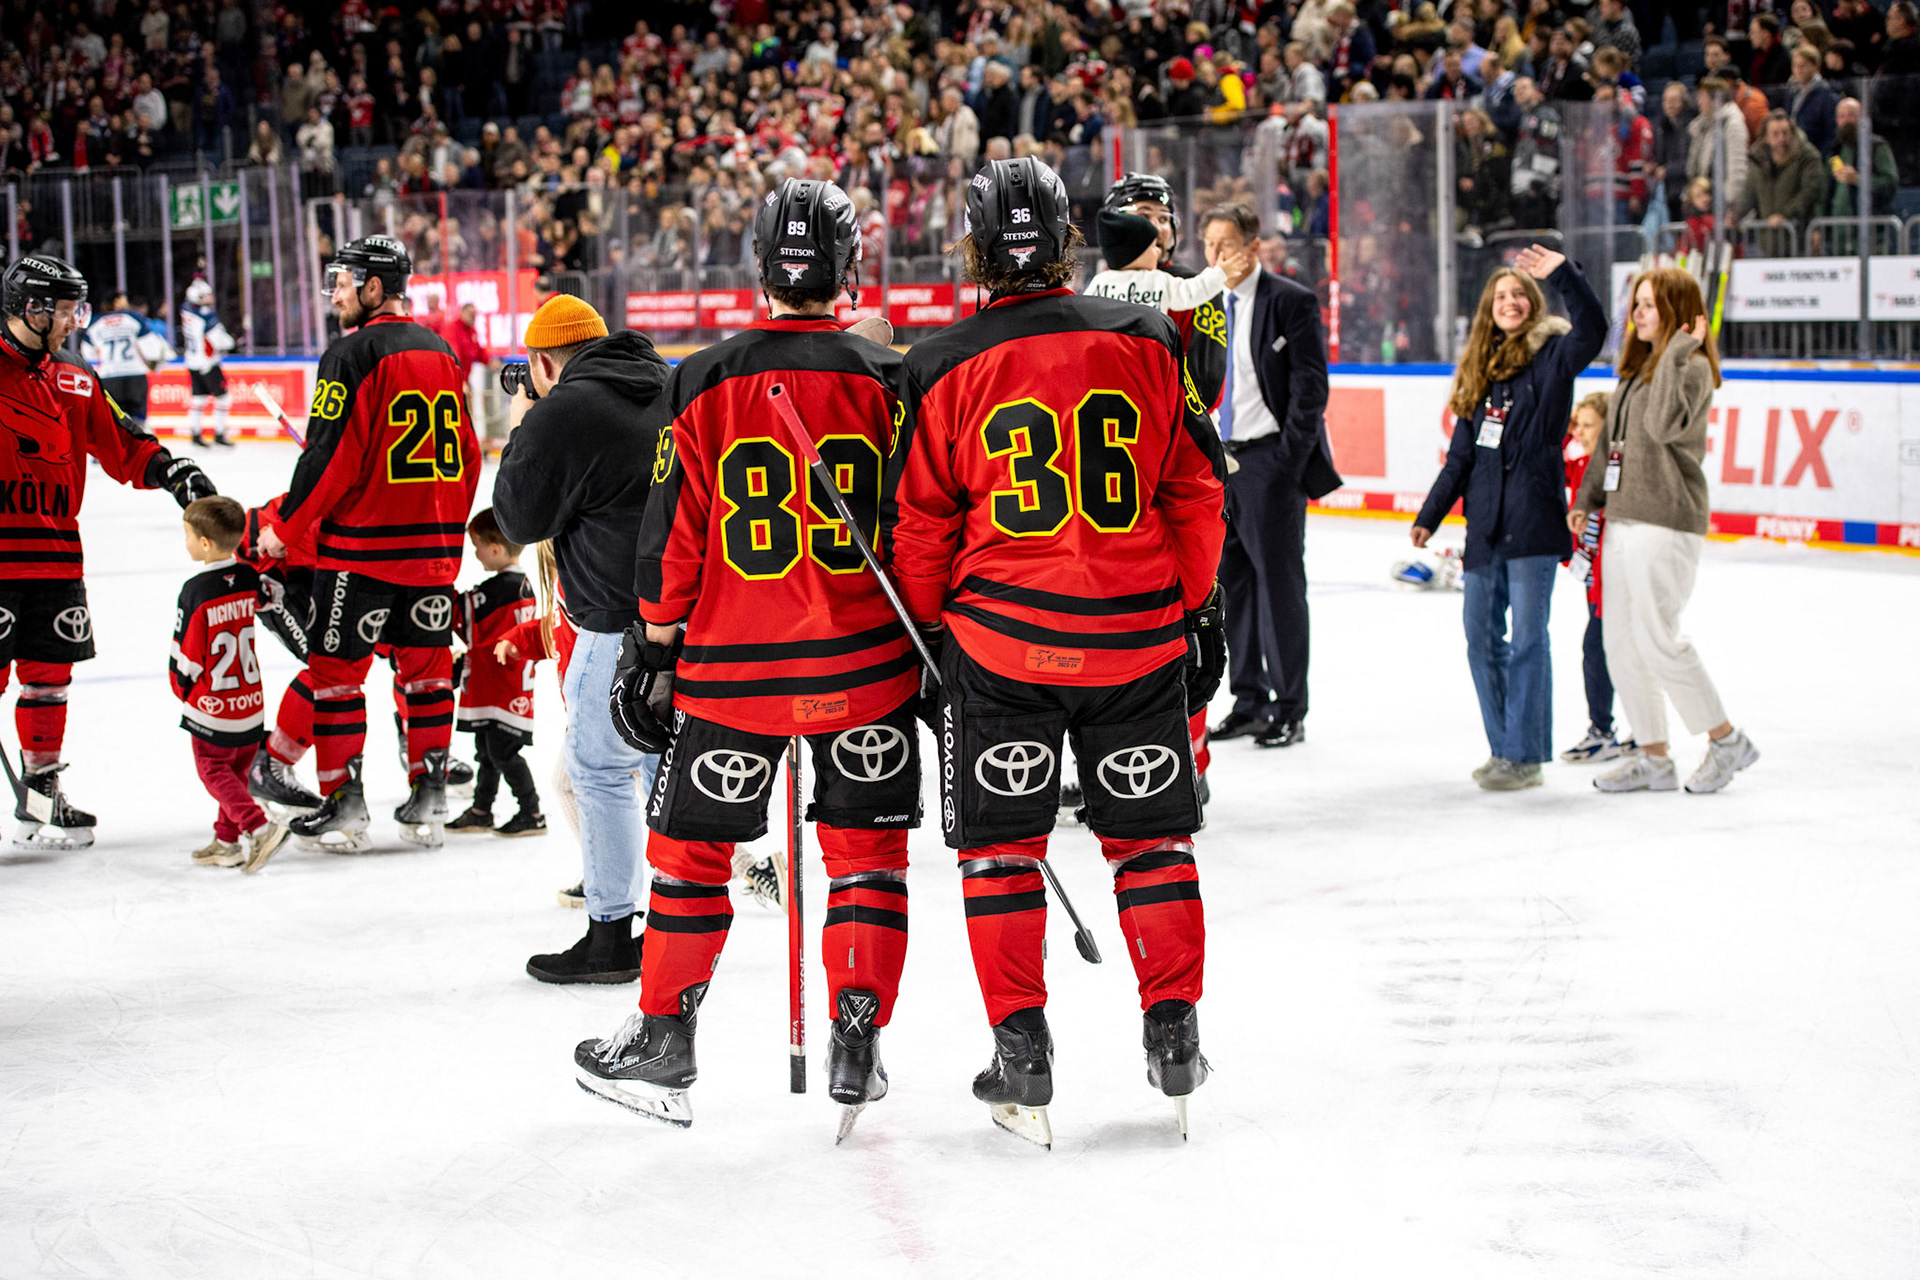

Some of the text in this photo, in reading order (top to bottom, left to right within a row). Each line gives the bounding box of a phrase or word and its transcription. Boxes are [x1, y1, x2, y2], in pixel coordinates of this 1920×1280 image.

[787, 221, 807, 236] 89
[1011, 207, 1031, 225] 36
[364, 238, 407, 257] STETSON
[780, 247, 815, 257] STETSON
[1003, 230, 1039, 241] STETSON
[21, 257, 62, 279] STETSON
[1093, 282, 1164, 308] Mickey
[1193, 302, 1227, 348] 82
[104, 338, 134, 361] 72
[311, 379, 348, 420] 26
[388, 390, 465, 483] 26
[980, 388, 1141, 538] 36
[0, 473, 70, 518] KÖLN
[718, 434, 882, 581] 89
[1756, 515, 1819, 542] PENNY
[329, 570, 350, 627] TOYOTA
[282, 608, 309, 655] TOYOTA
[210, 626, 261, 692] 26
[943, 702, 955, 793] TOYOTA
[651, 737, 678, 817] TOYOTA
[873, 814, 909, 823] BAUER
[831, 1087, 860, 1097] BAUER
